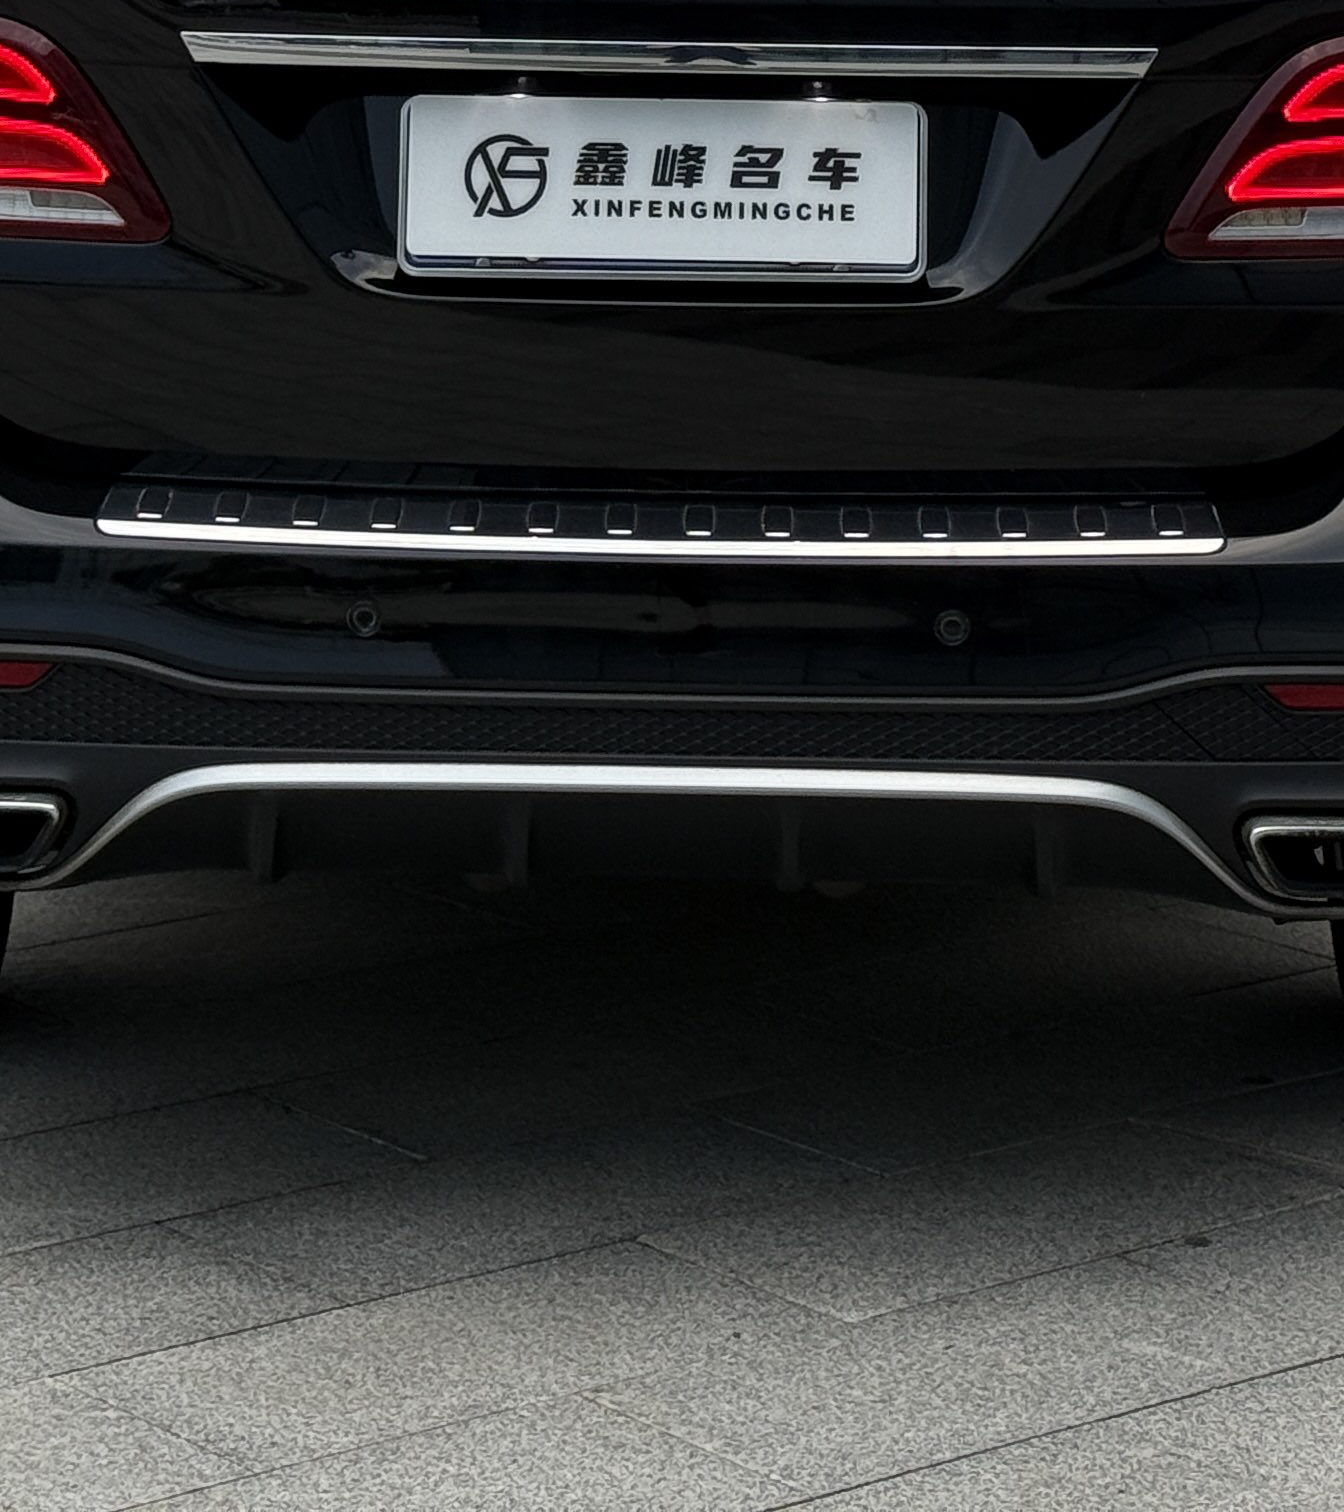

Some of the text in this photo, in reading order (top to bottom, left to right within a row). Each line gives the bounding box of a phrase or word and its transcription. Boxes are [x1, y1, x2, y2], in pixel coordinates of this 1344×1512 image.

[573, 142, 862, 191] 鑫峰名车
[571, 198, 857, 222] XINFENGMINGCHE
